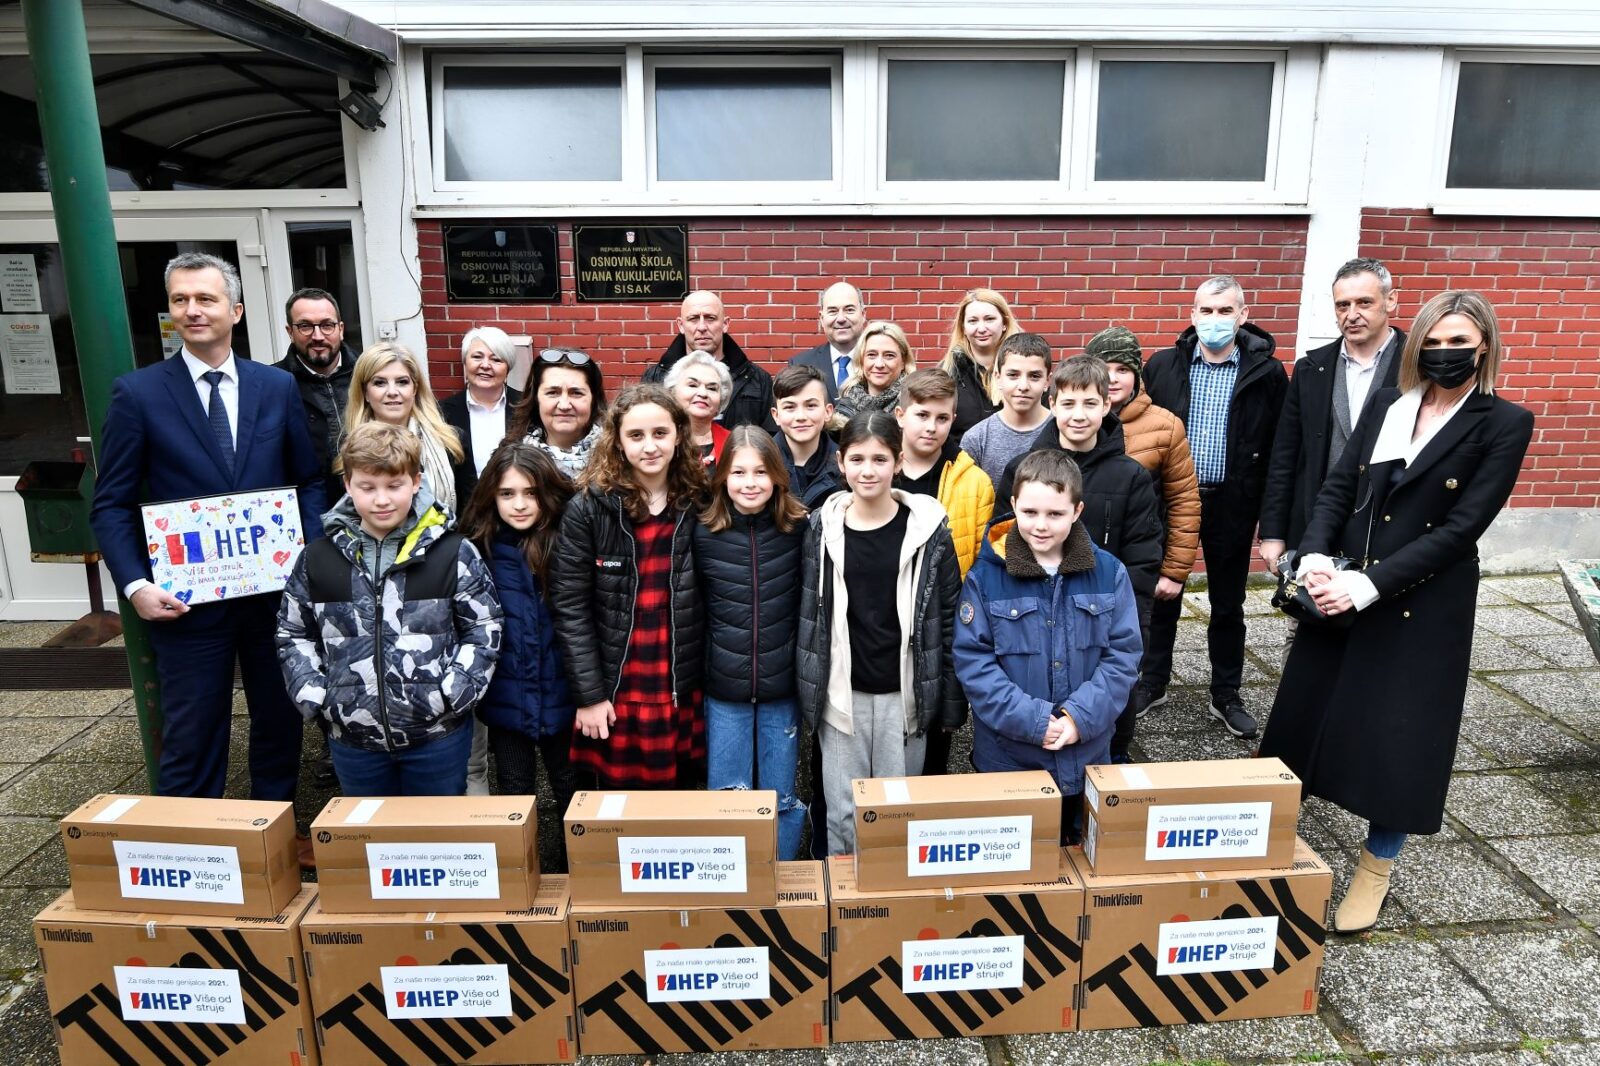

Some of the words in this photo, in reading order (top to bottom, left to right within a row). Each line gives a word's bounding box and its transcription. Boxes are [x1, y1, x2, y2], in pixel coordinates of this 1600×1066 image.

[461, 263, 508, 271] OSNOVNA
[591, 257, 637, 267] OSNOVNA
[641, 255, 672, 267] ŠKOLA
[471, 275, 488, 284] 22.
[493, 275, 535, 284] LIPNJA
[582, 271, 612, 281] IVANA
[615, 269, 682, 281] KUKULJEVIĆA
[614, 284, 651, 294] SISAK
[215, 525, 265, 559] HEP
[232, 585, 259, 594] SISAK
[1106, 795, 1119, 807] hp
[864, 811, 876, 823] hp
[68, 827, 80, 839] hp
[572, 824, 584, 836] hp
[318, 831, 331, 843] hp
[1178, 829, 1218, 847] HEP
[1222, 828, 1242, 837] Više
[1245, 828, 1258, 836] od
[1221, 838, 1248, 847] struje
[138, 852, 155, 860] naše
[940, 843, 980, 862] HEP
[983, 842, 1005, 851] Više
[983, 852, 1011, 860] struje
[653, 862, 694, 879] HEP
[697, 862, 719, 870] Više
[152, 869, 191, 888] HEP
[194, 870, 215, 880] Više
[218, 872, 230, 881] od
[405, 869, 445, 886] HEP
[448, 869, 470, 877] Više
[473, 869, 487, 877] od
[698, 873, 726, 881] struje
[195, 881, 223, 891] struje
[449, 879, 478, 888] struje
[778, 892, 817, 902] ThinkVisi
[1093, 894, 1142, 907] ThinkVision
[838, 907, 889, 919] ThinkVision
[577, 920, 628, 932] ThinkVision
[41, 928, 92, 943] ThinkVision
[309, 932, 362, 944] ThinkVision
[1189, 944, 1228, 962] HEP
[1230, 942, 1251, 951] Više
[1253, 942, 1265, 950] od
[934, 963, 973, 980] HEP
[976, 961, 998, 970] Više
[976, 971, 1004, 979] struje
[139, 976, 155, 984] naše
[679, 973, 719, 990] HEP
[721, 972, 743, 980] Više
[745, 972, 758, 980] od
[722, 982, 750, 990] struje
[152, 993, 192, 1010] HEP
[194, 994, 215, 1004] Više
[217, 995, 231, 1003] od
[419, 991, 458, 1007] HEP
[461, 990, 483, 998] Više
[463, 999, 491, 1007] struje
[196, 1004, 224, 1013] struje
